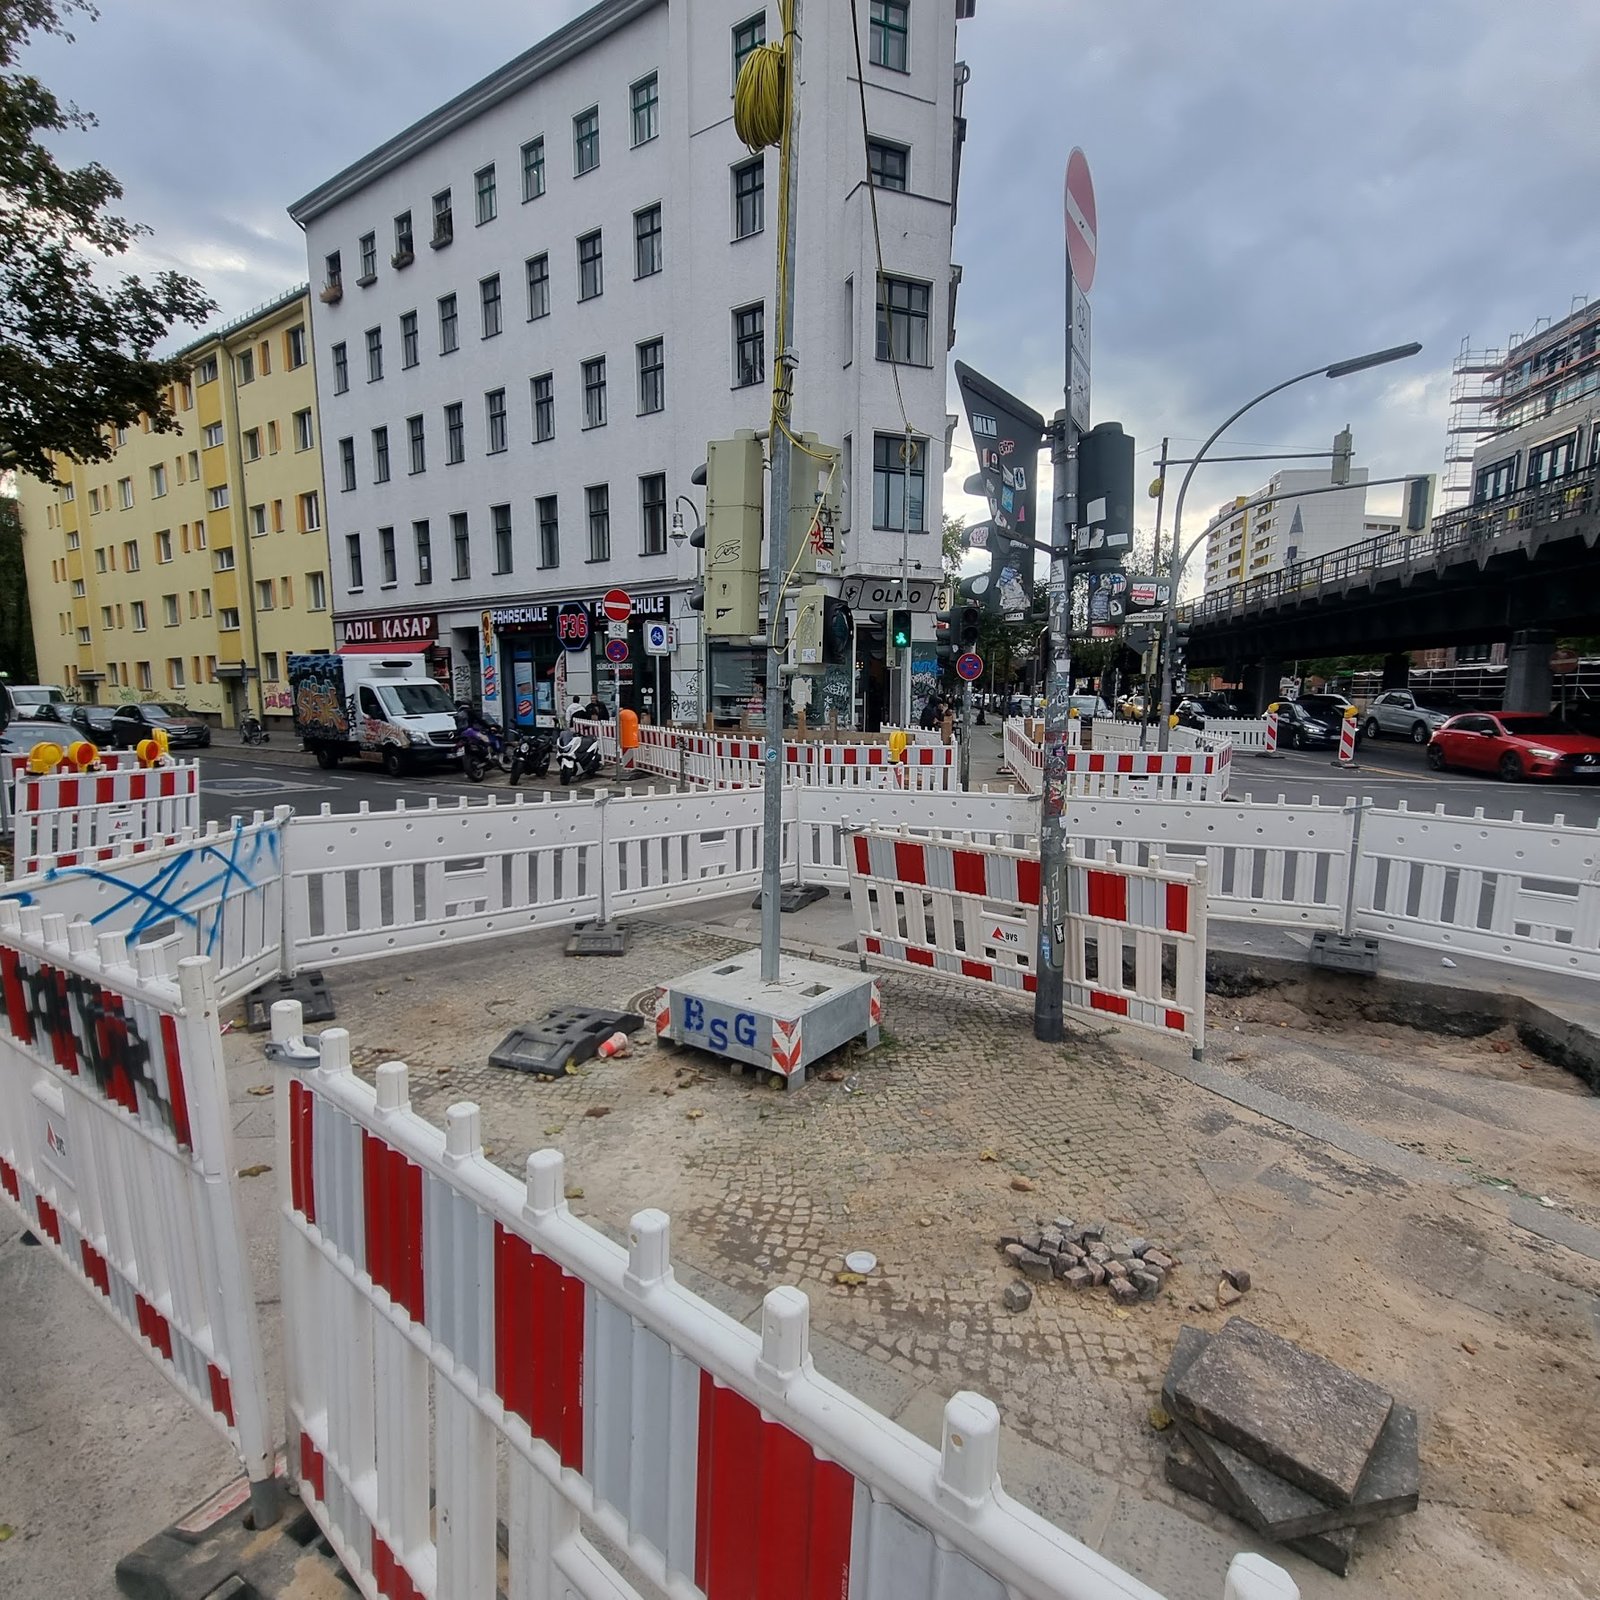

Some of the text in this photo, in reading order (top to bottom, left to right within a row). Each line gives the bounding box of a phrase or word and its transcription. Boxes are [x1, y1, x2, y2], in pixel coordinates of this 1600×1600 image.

[493, 606, 548, 625] FAHRSCHULE
[595, 596, 664, 617] FCHULE
[345, 616, 431, 641] ADIL KASAP
[559, 613, 588, 639] F36
[1005, 932, 1018, 942] BVS
[683, 997, 757, 1050] BSG
